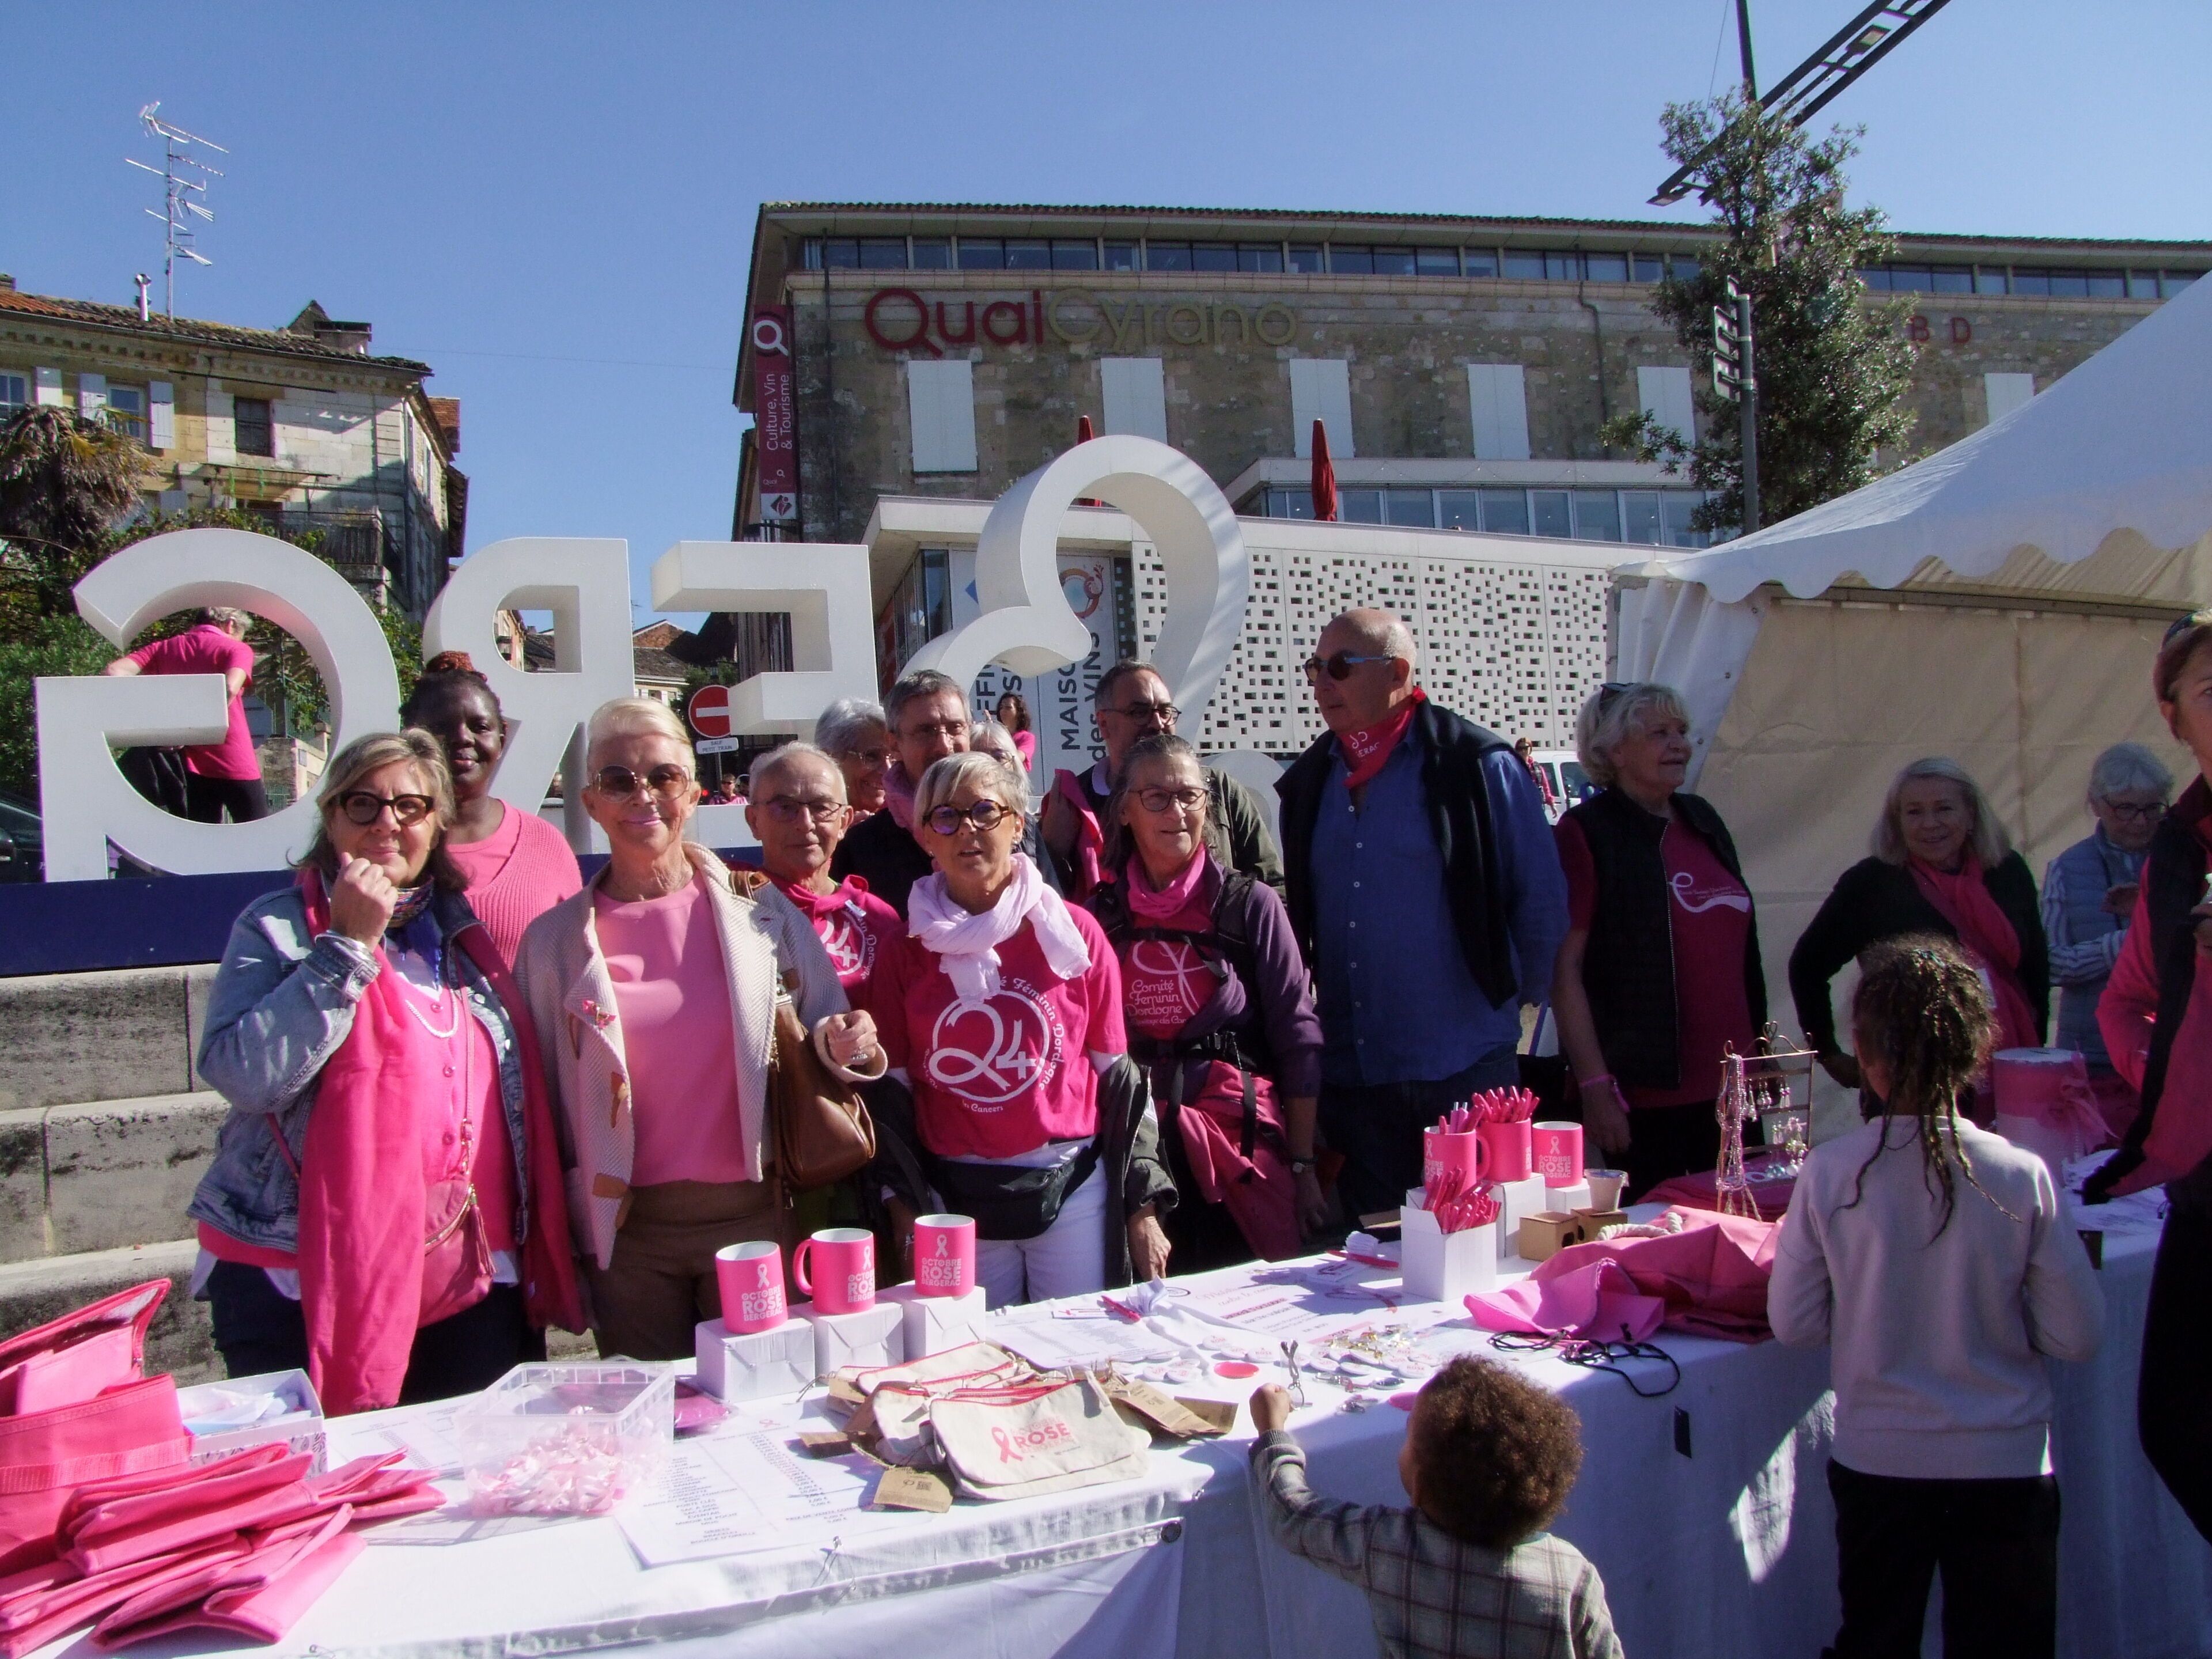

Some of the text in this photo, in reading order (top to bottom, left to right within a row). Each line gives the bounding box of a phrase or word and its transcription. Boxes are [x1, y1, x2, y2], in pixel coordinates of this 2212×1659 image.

[764, 373, 778, 450] Culture, Vin
[779, 374, 792, 449] & Tourisme
[1131, 979, 1174, 993] Comité
[1124, 1002, 1183, 1017] Dordogne
[1013, 977, 1066, 1092] Féminin Dordogne
[971, 1103, 1004, 1113] Cancers
[1539, 1161, 1571, 1172] ROSE
[922, 1257, 962, 1267] OCTOBRE
[922, 1264, 961, 1280] ROSE
[921, 1277, 961, 1286] BERGERAC
[741, 1285, 782, 1300] OCTOBRE
[742, 1293, 782, 1315] ROSE
[743, 1306, 783, 1321] BERGERAC
[1013, 1422, 1070, 1448] ROSE
